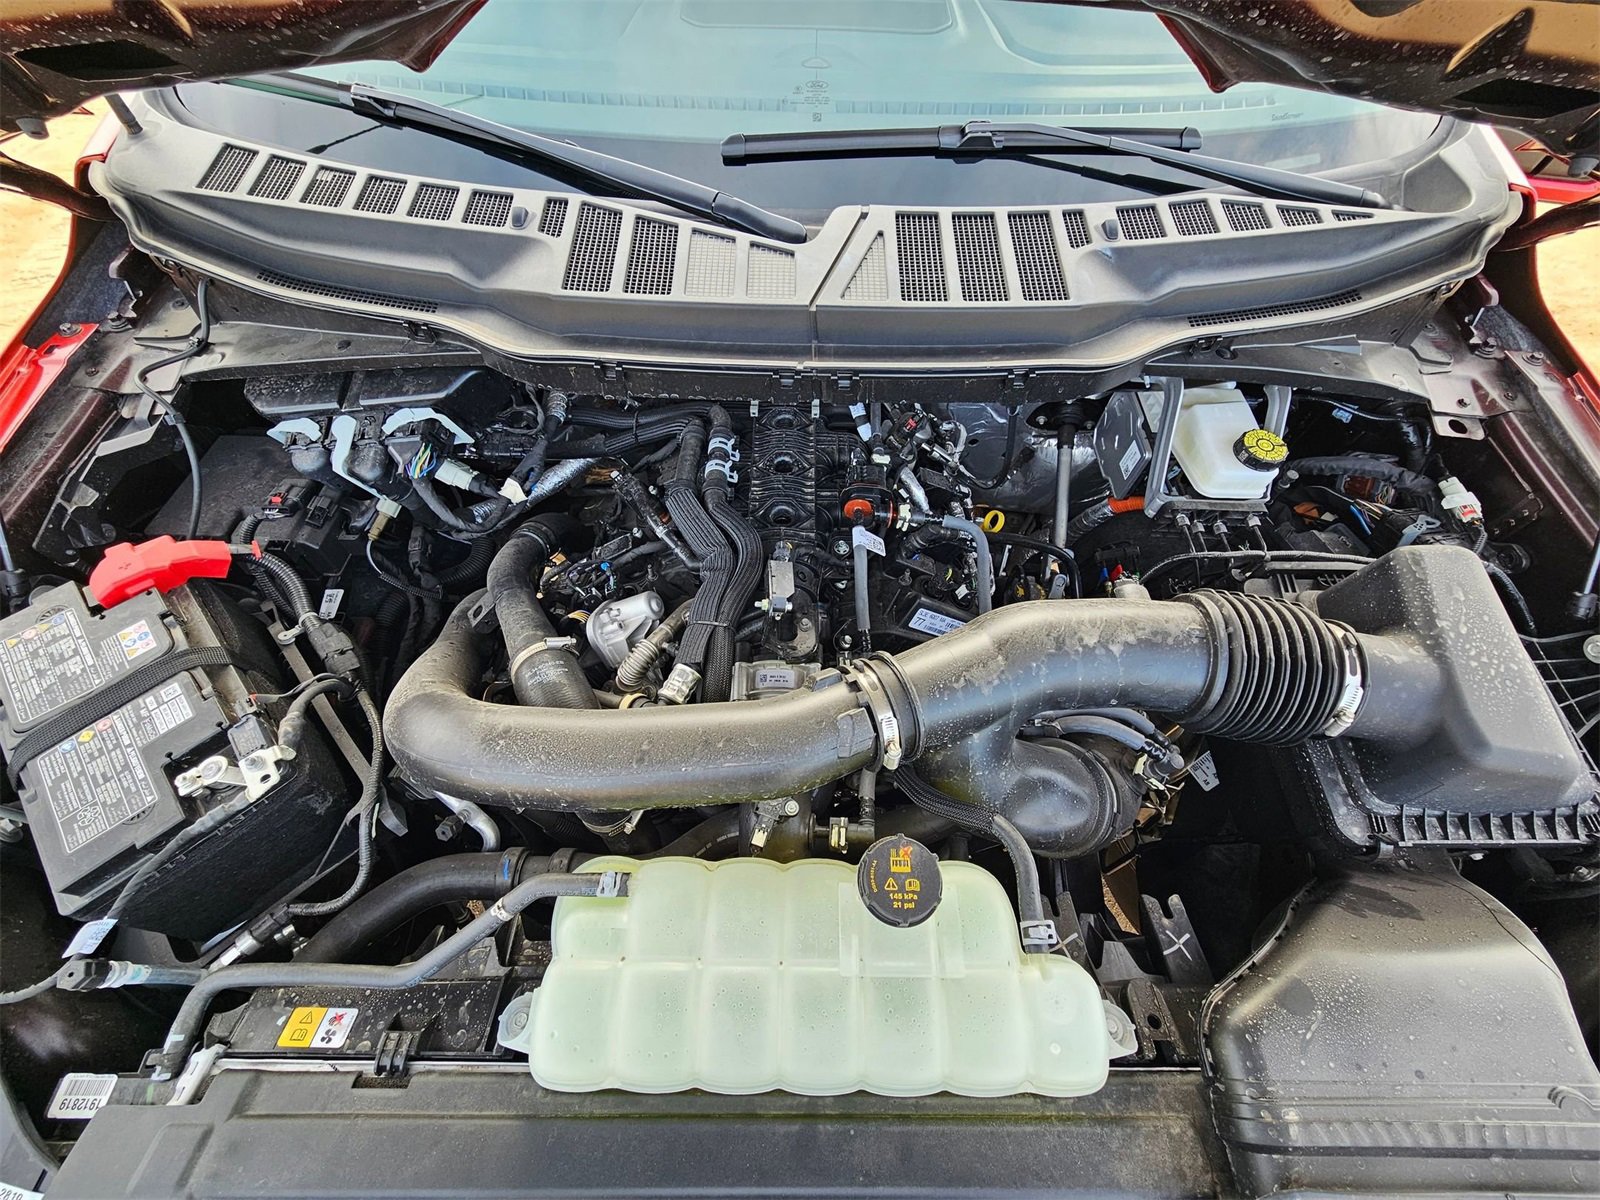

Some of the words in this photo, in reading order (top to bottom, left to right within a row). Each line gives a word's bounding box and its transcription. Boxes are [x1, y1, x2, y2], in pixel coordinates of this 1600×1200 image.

[914, 617, 925, 626] 77
[903, 901, 915, 910] psi
[58, 1097, 102, 1110] 1912819
